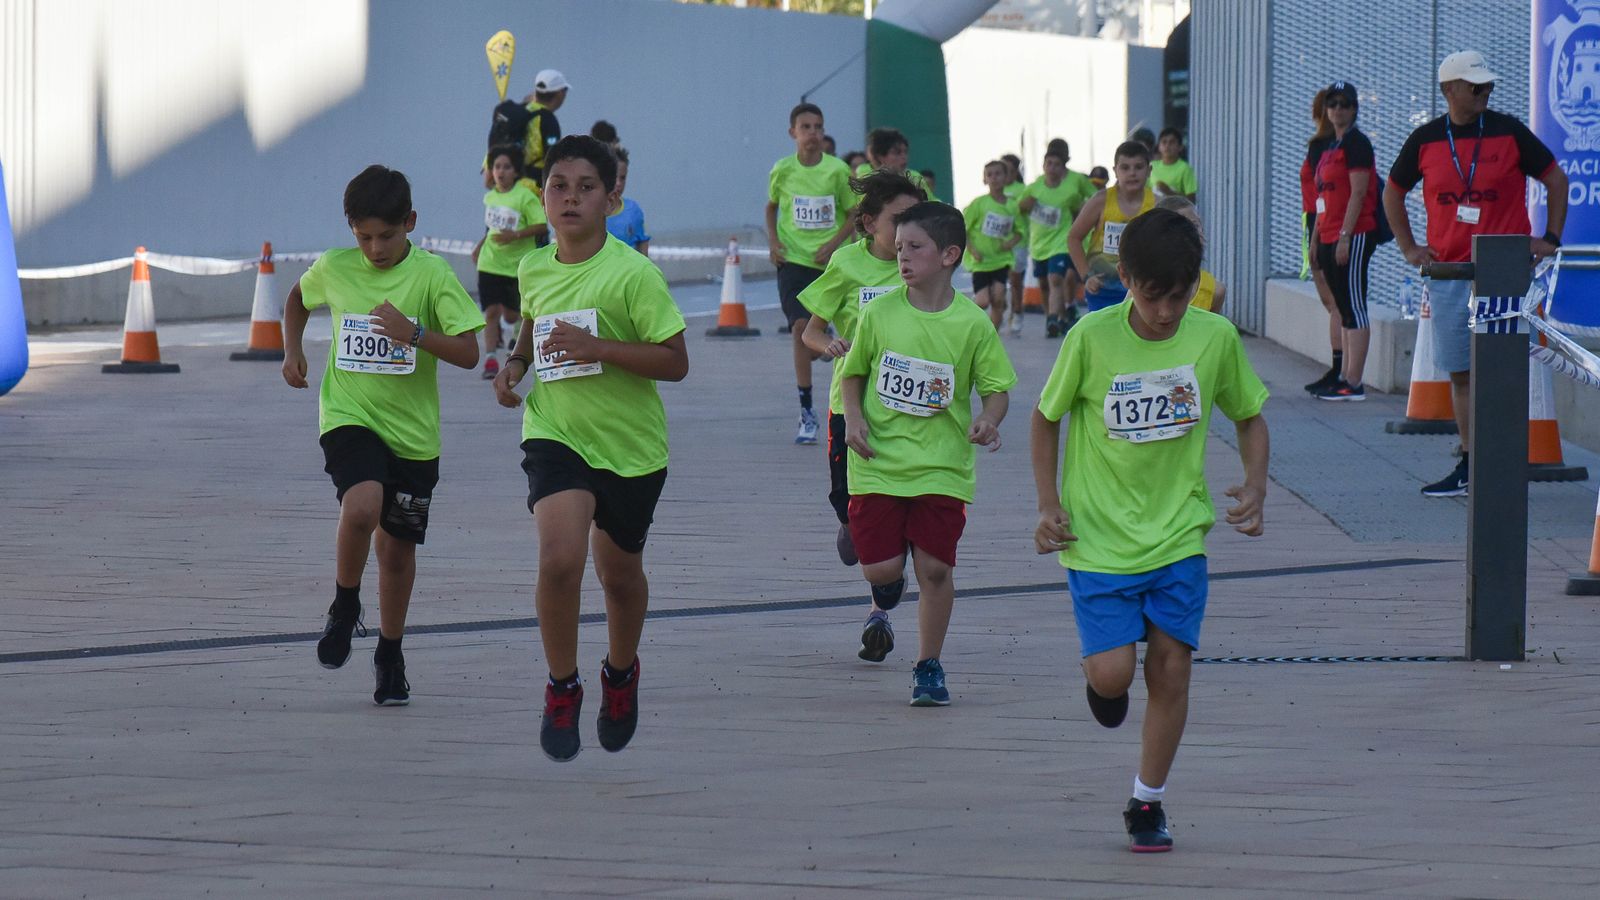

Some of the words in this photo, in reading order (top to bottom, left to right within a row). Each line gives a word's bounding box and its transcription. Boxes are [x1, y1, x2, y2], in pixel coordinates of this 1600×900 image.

[795, 207, 820, 220] 1311
[343, 318, 356, 328] XXI
[343, 334, 389, 358] 1390
[883, 355, 897, 367] XXI
[882, 371, 926, 401] 1391
[1110, 394, 1170, 425] 1372
